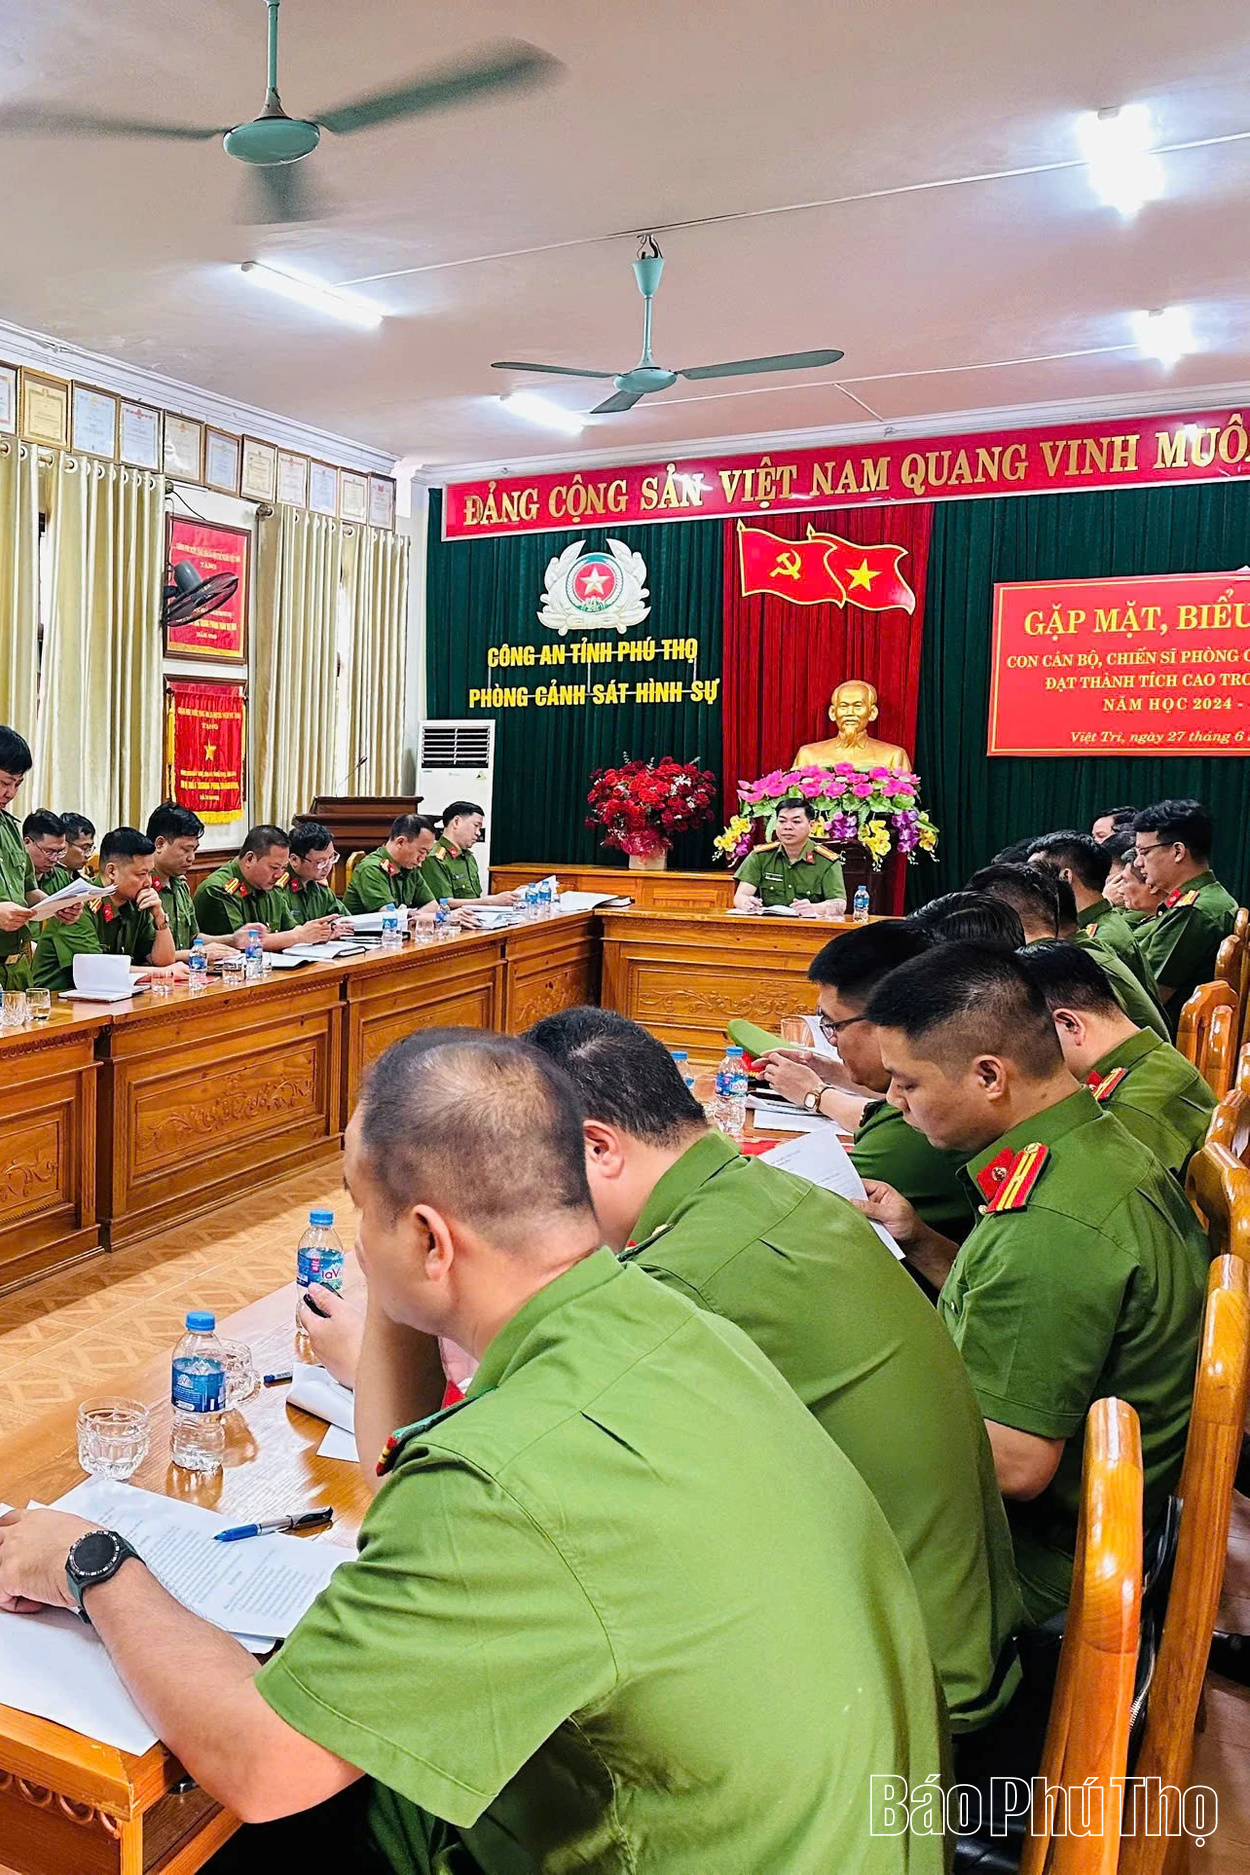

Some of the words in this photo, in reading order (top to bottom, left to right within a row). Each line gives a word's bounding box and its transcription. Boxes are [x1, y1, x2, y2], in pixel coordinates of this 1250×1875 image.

[464, 481, 539, 525] ĐẢNG
[550, 474, 628, 523] CỘNG
[641, 463, 703, 511] SẢN
[719, 456, 797, 508] VIỆT
[811, 456, 891, 496] NAM
[900, 444, 1028, 496] QUANG
[1040, 434, 1140, 478] VINH
[1153, 413, 1250, 469] MUÔ
[1024, 602, 1086, 641] GẶP
[1093, 600, 1168, 638] MẶT,
[488, 643, 535, 668] CÔNG
[540, 644, 565, 665] AN
[570, 637, 612, 663] TỈNH
[617, 636, 655, 662] PHÚ
[662, 638, 698, 664] THỌ
[1007, 655, 1038, 668] CON
[1042, 650, 1073, 667] CÁN
[1077, 650, 1103, 669] BỘ,
[1106, 646, 1157, 665] CHIẾN
[1160, 648, 1177, 664] SĨ
[1180, 646, 1239, 663] PHÒNG
[469, 683, 528, 708] PHÒNG
[535, 679, 585, 706] CẢNH
[592, 680, 629, 705] SÁT
[636, 678, 682, 703] HÌNH
[690, 678, 720, 704] SỰ
[1046, 677, 1076, 692] ĐẠT
[1080, 672, 1135, 688] THÀNH
[1139, 671, 1177, 688] TÍCH
[1182, 673, 1216, 686] CAO
[1103, 695, 1142, 711] NĂM
[1149, 697, 1188, 713] HỌC
[1193, 697, 1232, 710] 2024
[1070, 732, 1097, 744] Việt
[1101, 732, 1125, 744] Trì,
[1130, 732, 1164, 744] ngày
[1167, 731, 1187, 742] 27
[1189, 730, 1231, 744] tháng
[1235, 731, 1244, 742] 6
